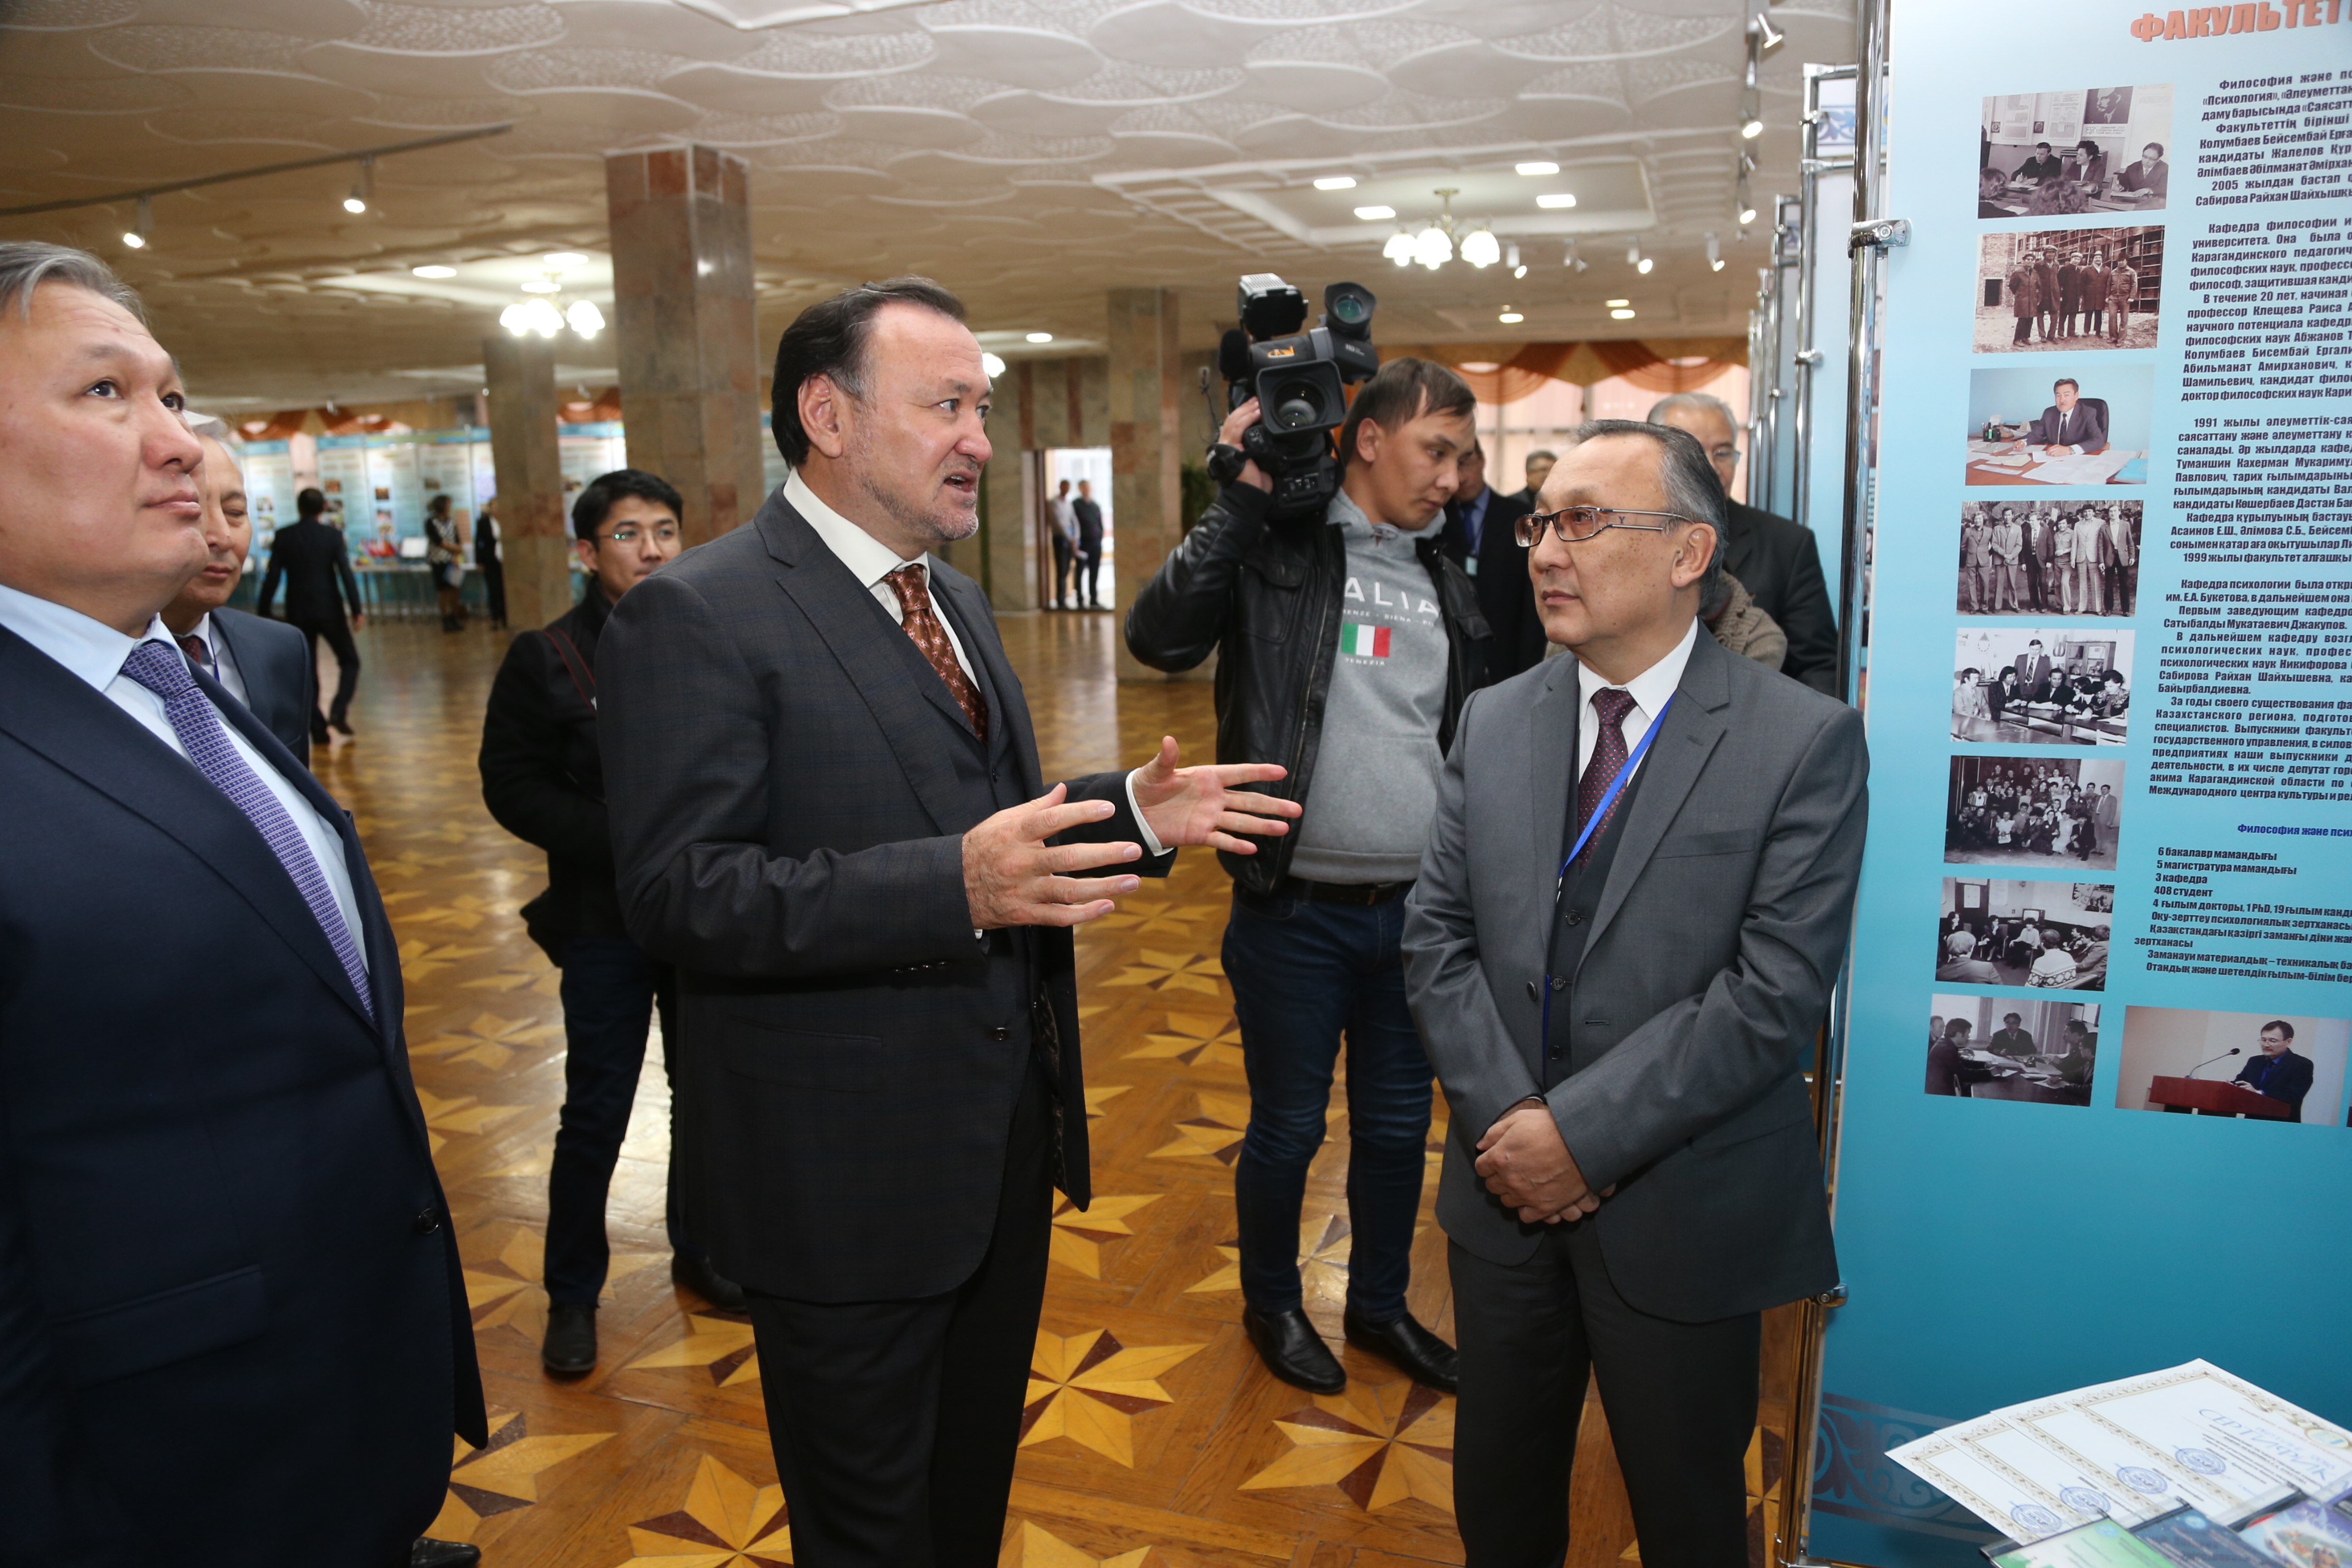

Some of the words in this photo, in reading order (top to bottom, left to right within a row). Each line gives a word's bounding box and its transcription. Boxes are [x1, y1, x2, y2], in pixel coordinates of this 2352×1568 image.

[2219, 76, 2292, 90] Философия
[2299, 72, 2332, 83] және
[2201, 110, 2231, 122] даму
[2232, 105, 2300, 118] барысында
[2216, 118, 2296, 133] Факультеттің
[2304, 113, 2349, 127] бірінші
[2199, 136, 2261, 149] Колумбаев
[2262, 130, 2327, 145] Бейсембай
[2198, 151, 2264, 163] кандидаты
[2271, 146, 2324, 159] Жалелов
[2197, 166, 2248, 178] Әлімбаев
[2249, 162, 2309, 175] Әбілманат
[2211, 180, 2238, 191] 2005
[2245, 178, 2294, 189] жылдан
[2300, 174, 2341, 185] бастап
[2195, 195, 2248, 206] Сабирова
[2249, 192, 2289, 203] Райхан
[2208, 223, 2260, 234] Кафедра
[2266, 218, 2337, 231] философии
[2192, 236, 2270, 250] университета.
[2276, 234, 2296, 244] Она
[2309, 232, 2341, 242] была
[2191, 250, 2287, 263] Карагандинского
[2190, 265, 2268, 277] философских
[2269, 263, 2297, 273] наук,
[2189, 279, 2243, 291] философ,
[2244, 277, 2317, 288] защитившая
[2213, 293, 2257, 303] течение
[2300, 289, 2348, 300] начиная
[2187, 308, 2247, 319] профессор
[2253, 306, 2303, 316] Клещева
[2309, 303, 2342, 313] Раиса
[2186, 322, 2235, 333] научного
[2238, 320, 2303, 330] потенциала
[2185, 335, 2262, 347] философских
[2265, 334, 2291, 344] наук
[2293, 332, 2343, 342] Абжанов
[2184, 349, 2245, 360] Колумбаев
[2252, 346, 2309, 357] Бисембай
[2183, 363, 2252, 373] Абильманат
[2258, 361, 2338, 372] Амирханович,
[2182, 377, 2255, 387] Шамильевич,
[2260, 375, 2314, 386] кандидат
[2180, 391, 2219, 402] доктор
[2220, 389, 2297, 401] философских
[2298, 389, 2324, 399] наук
[2194, 418, 2217, 428] 1991
[2223, 419, 2260, 427] жылы
[2178, 432, 2238, 442] саясаттану
[2240, 432, 2268, 440] және
[2272, 430, 2342, 440] әлеуметтану
[2177, 446, 2234, 456] саналады.
[2255, 445, 2316, 455] жылдарда
[2176, 459, 2231, 470] Туманшин
[2237, 458, 2289, 469] Кахерман
[2175, 472, 2228, 482] Павлович,
[2233, 473, 2263, 482] тарих
[2173, 486, 2263, 496] ғылымдарының
[2266, 486, 2330, 496] кандидаты
[2173, 500, 2234, 510] кандидаты
[2235, 499, 2295, 509] Көшербаев
[2295, 498, 2335, 509] Дастан
[2186, 512, 2234, 523] Кафедра
[2236, 513, 2309, 523] құрылуының
[2170, 526, 2214, 535] Асаинов
[2240, 526, 2283, 535] Әлімова
[2170, 541, 2218, 549] сонымен
[2219, 541, 2249, 550] қатар
[2250, 541, 2266, 549] аға
[2267, 541, 2340, 550] оқытушылар
[2183, 552, 2207, 562] 1999
[2208, 554, 2243, 562] жылы
[2243, 553, 2301, 563] факультет
[2180, 579, 2228, 590] Кафедра
[2229, 581, 2291, 589] психологии
[2294, 579, 2324, 589] была
[2200, 592, 2249, 603] Букетова,
[2258, 593, 2330, 603] дальнейшем
[2331, 595, 2350, 603] она
[2178, 605, 2221, 616] Первым
[2226, 607, 2299, 617] заведующим
[1384, 614, 1411, 622] SIENA
[2163, 618, 2226, 629] Сатыбалды
[2226, 619, 2290, 629] Мукатаевич
[2290, 620, 2347, 630] Джакупов.
[2189, 632, 2262, 642] дальнейшем
[2268, 633, 2318, 644] кафедру
[2161, 646, 2262, 655] психологических
[2269, 647, 2298, 656] наук,
[1345, 656, 1386, 666] VENEZIA
[2160, 659, 2249, 668] психологических
[2252, 660, 2276, 669] наук
[2280, 659, 2347, 670] Никифорова
[2159, 670, 2209, 681] Сабирова
[2215, 671, 2252, 681] Райхан
[2258, 672, 2333, 683] Шайхышевна,
[2158, 683, 2251, 695] Байырбалдиевна.
[2185, 698, 2212, 707] годы
[2214, 699, 2249, 707] своего
[2251, 699, 2334, 709] существования
[2155, 709, 2242, 720] Казахстанского
[2248, 713, 2296, 722] региона,
[2154, 723, 2229, 732] специалистов.
[2234, 723, 2300, 734] Выпускники
[2153, 736, 2245, 746] государственного
[2246, 738, 2310, 748] управления,
[2152, 749, 2228, 758] предприятиях
[2234, 751, 2264, 759] наши
[2269, 752, 2338, 762] выпускники
[2150, 761, 2225, 772] деятельности,
[2252, 764, 2285, 773] числе
[2287, 765, 2331, 774] депутат
[2149, 774, 2182, 782] акима
[2188, 773, 2275, 786] Карагандинской
[2281, 776, 2325, 787] области
[2148, 785, 2237, 797] Международного
[2240, 790, 2276, 799] центра
[2277, 791, 2329, 800] культуры
[2237, 823, 2300, 835] Философия
[2301, 827, 2329, 836] және
[2165, 847, 2213, 859] бакалавр
[2213, 850, 2277, 861] мамандығы
[2164, 862, 2232, 872] магистратура
[2233, 865, 2297, 875] мамандығы
[2162, 874, 2208, 885] кафедра
[2153, 886, 2172, 895] 408
[2173, 888, 2213, 897] студент
[2161, 900, 2197, 909] ғылым
[2197, 902, 2245, 912] докторы,
[2251, 903, 2272, 914] PhD,
[2285, 906, 2323, 916] ғылым
[2211, 916, 2291, 928] психологиялық
[2149, 924, 2227, 937] Қазақстандағы
[2227, 929, 2262, 939] қазіргі
[2263, 932, 2308, 941] заманғы
[2309, 933, 2333, 943] діни
[2134, 937, 2193, 948] зертханасы
[2147, 949, 2196, 961] Заманауи
[2196, 953, 2268, 966] материалдық
[2276, 958, 2339, 969] техникалық
[2146, 962, 2190, 974] Отандық
[2191, 966, 2217, 974] және
[2218, 968, 2267, 978] шетелдік
[2267, 970, 2336, 982] ғылым-білім
